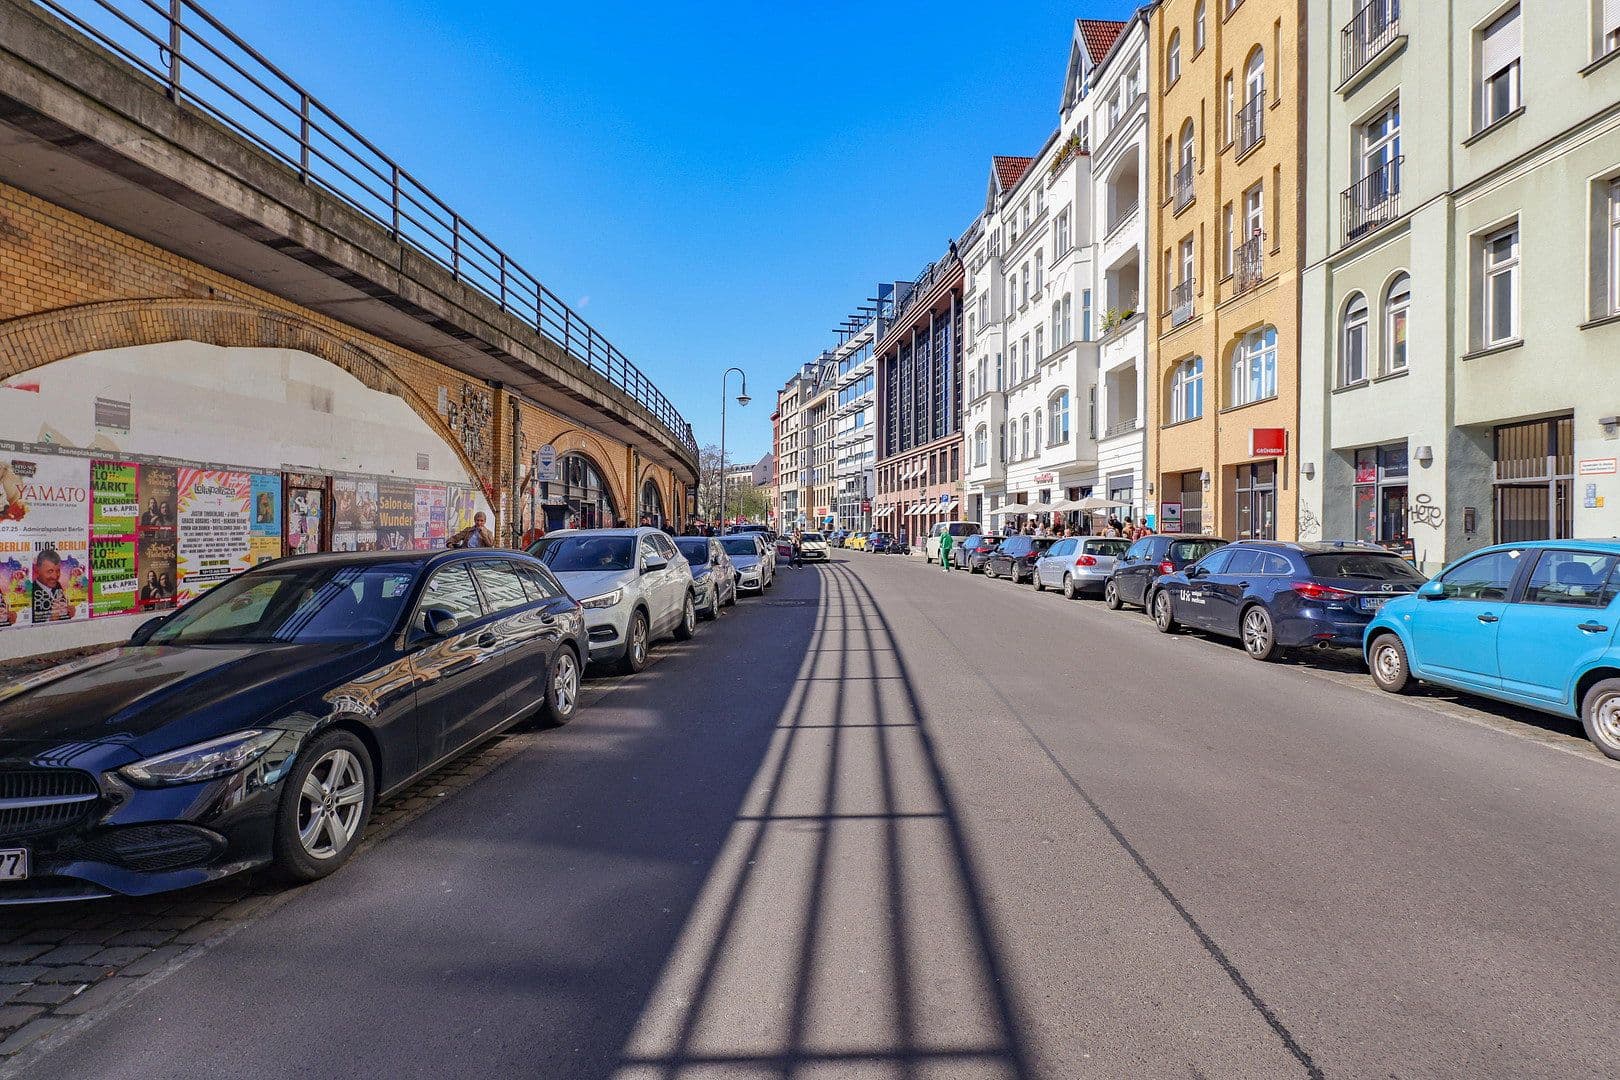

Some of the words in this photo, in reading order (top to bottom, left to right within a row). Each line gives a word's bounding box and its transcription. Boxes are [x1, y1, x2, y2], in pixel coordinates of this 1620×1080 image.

[15, 484, 86, 502] YAMATO
[380, 495, 402, 510] Salon
[402, 500, 413, 510] der
[380, 512, 413, 527] Wunder
[58, 540, 87, 551] BERLIN
[89, 558, 127, 569] MARKT
[120, 579, 137, 587] APRIL
